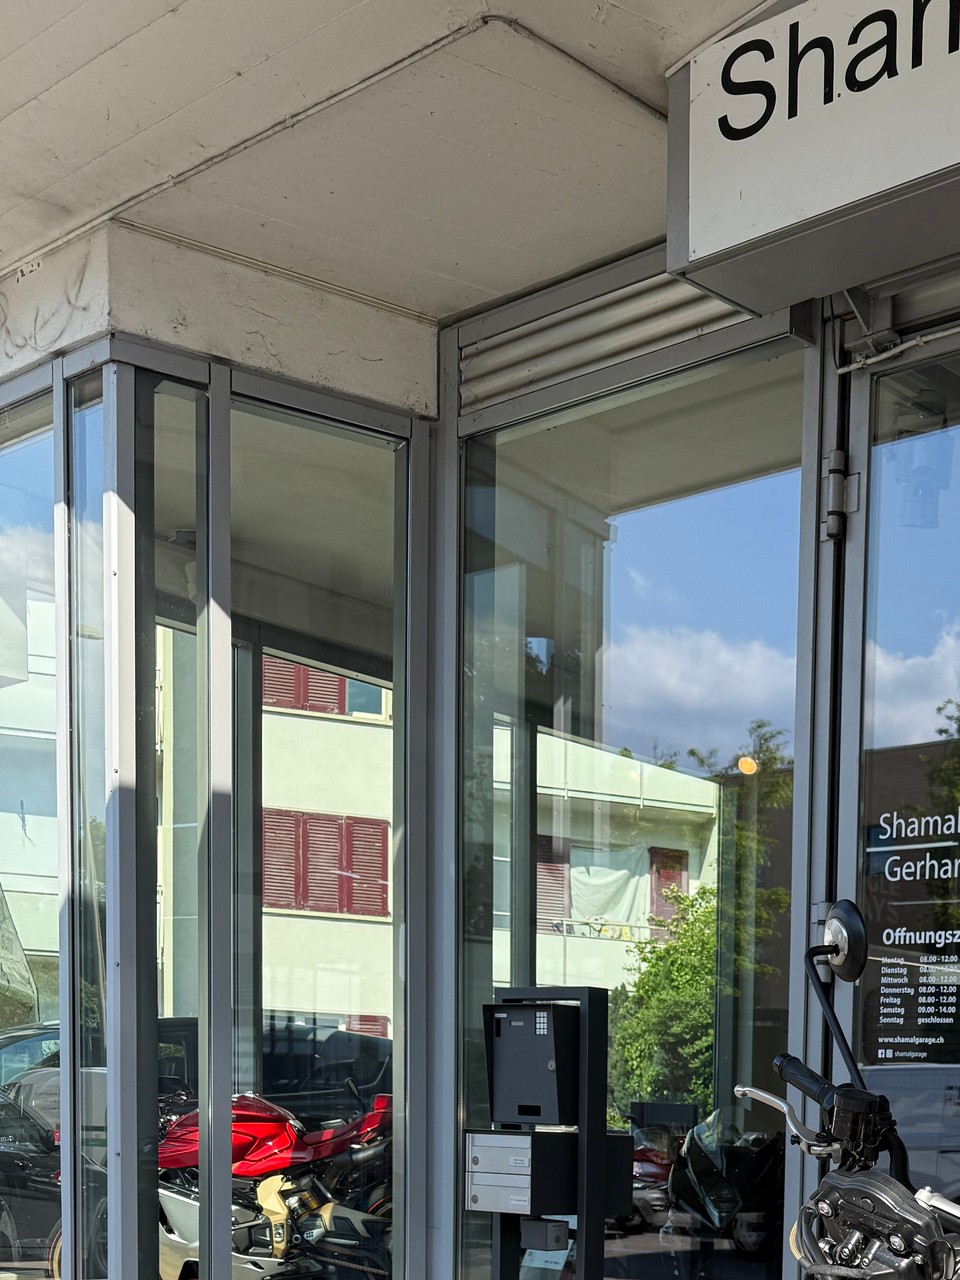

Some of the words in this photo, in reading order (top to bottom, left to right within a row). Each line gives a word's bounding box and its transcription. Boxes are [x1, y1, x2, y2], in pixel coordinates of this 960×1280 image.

[881, 976, 908, 984] Mittwoch
[881, 987, 914, 995] Donnerstag
[918, 1016, 954, 1024] geschlossen
[878, 1036, 944, 1044] www.shamalgarage.ch
